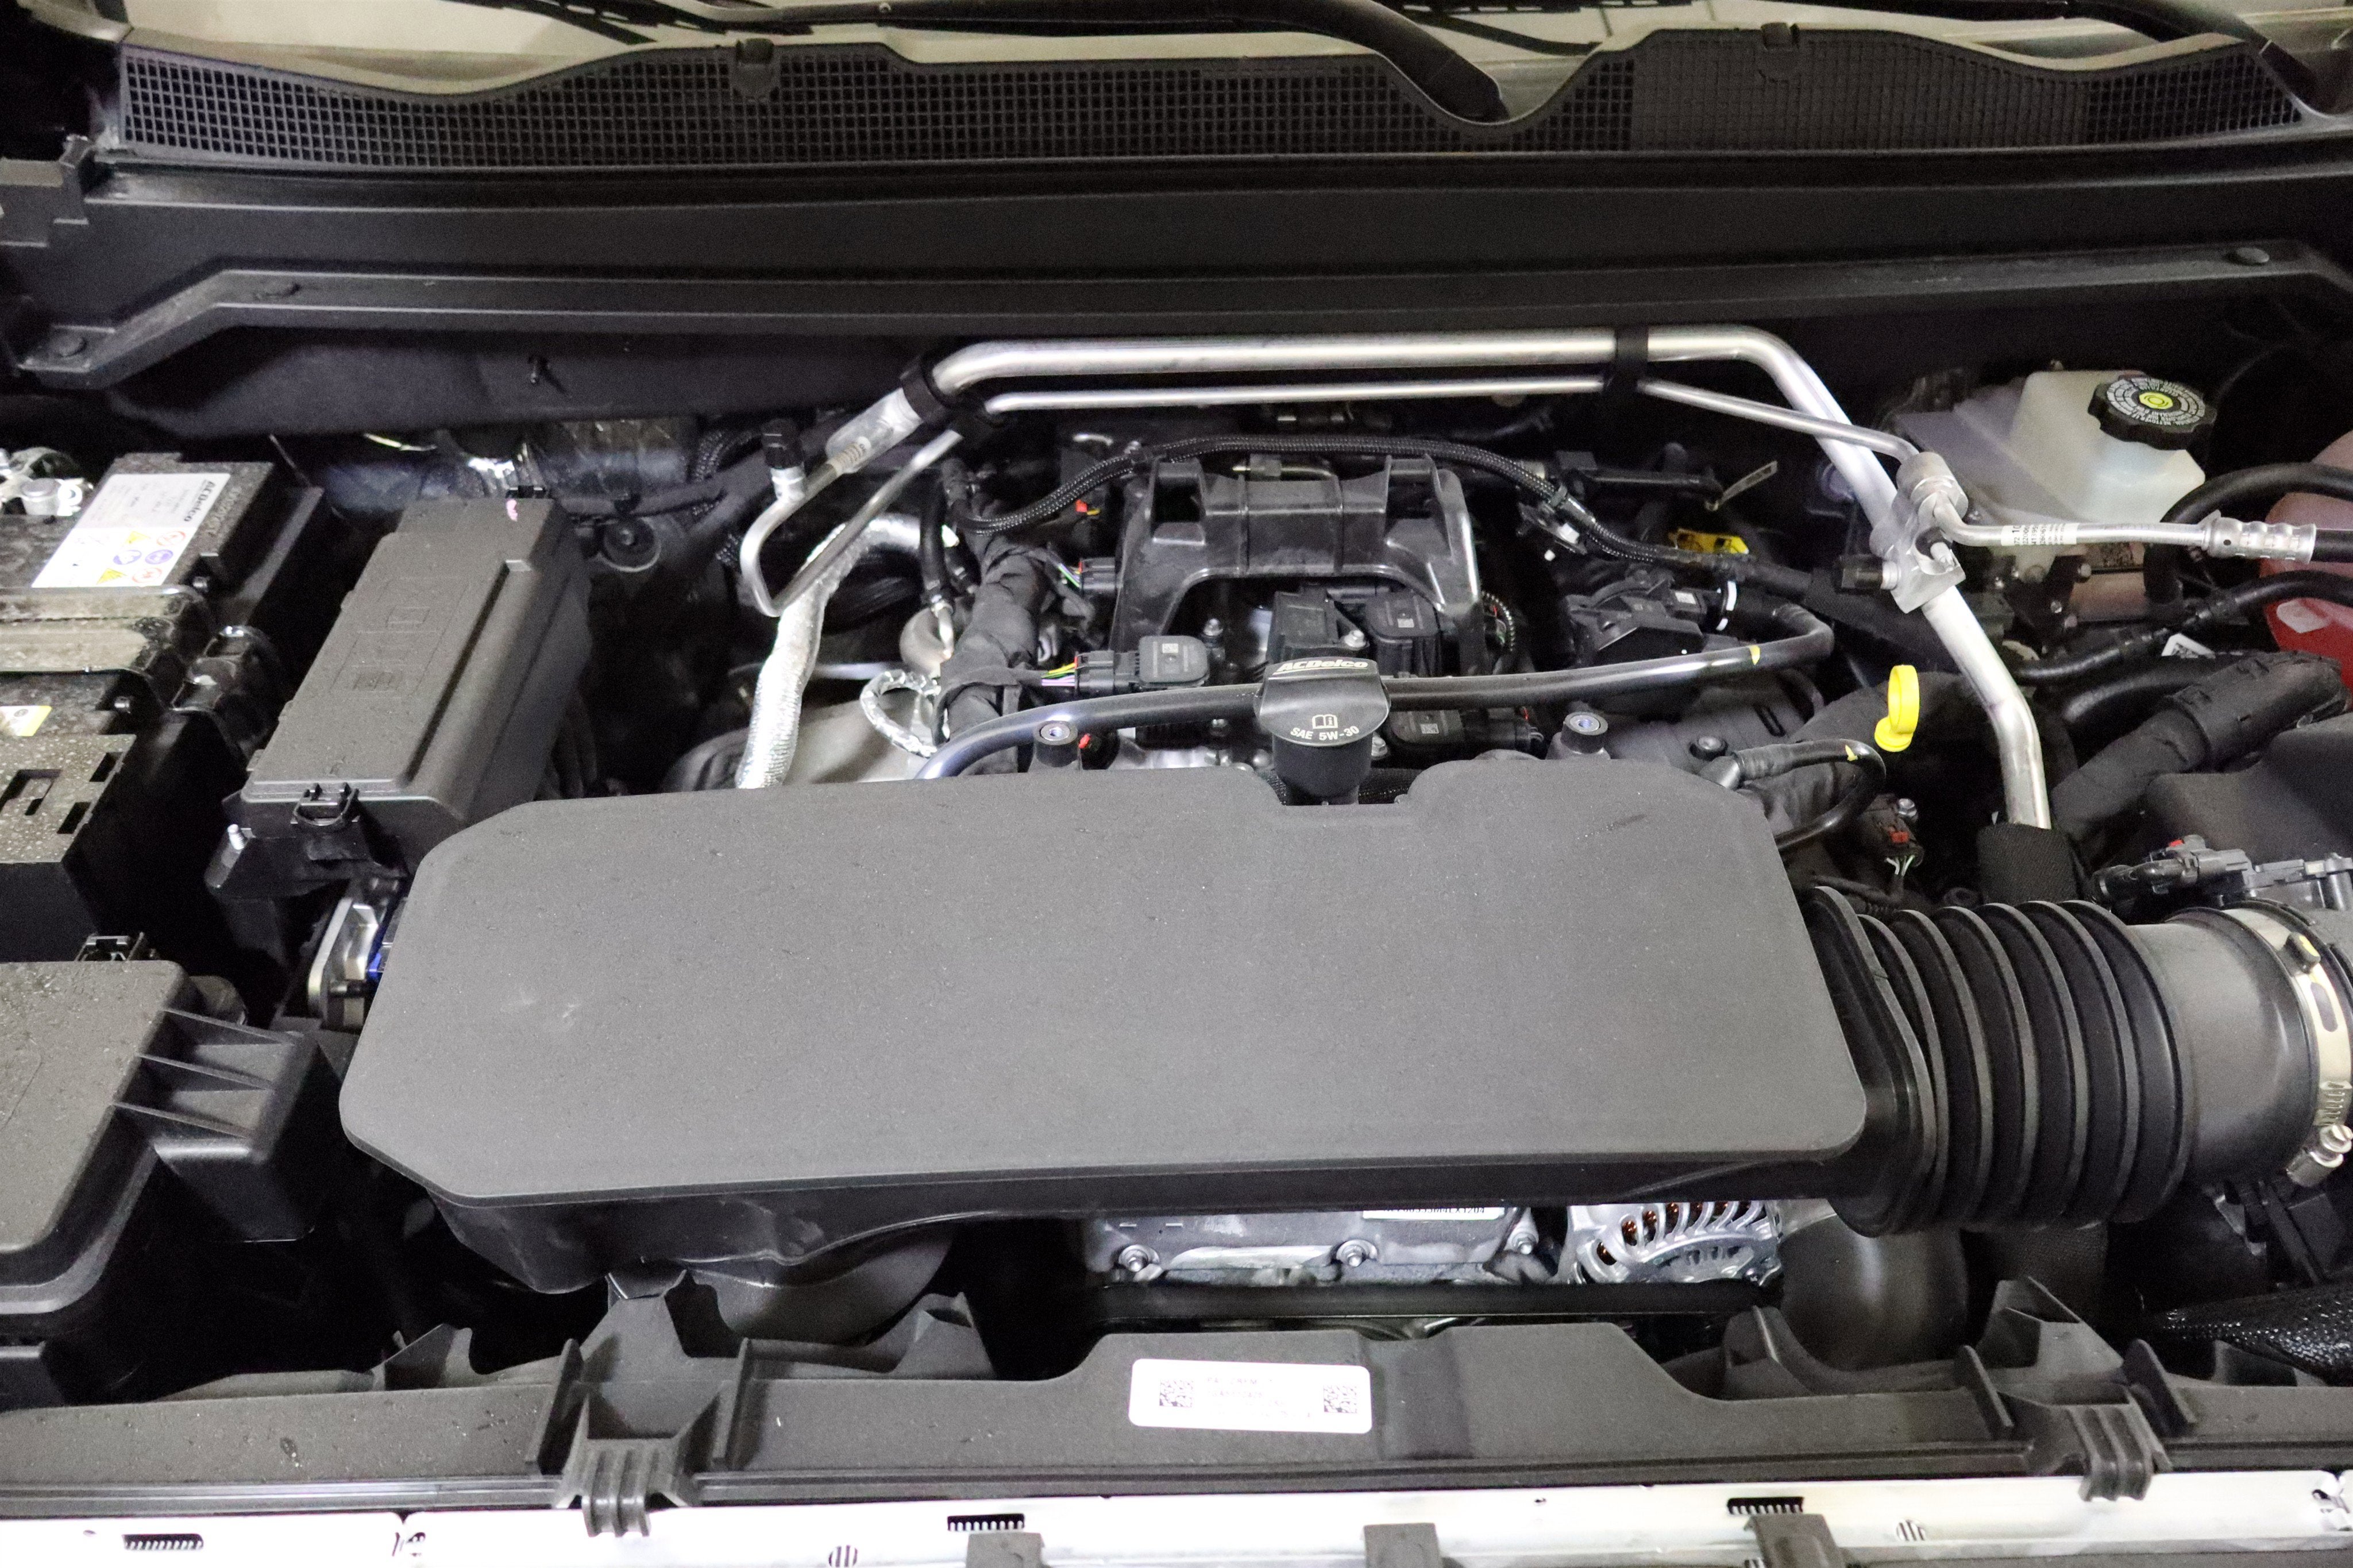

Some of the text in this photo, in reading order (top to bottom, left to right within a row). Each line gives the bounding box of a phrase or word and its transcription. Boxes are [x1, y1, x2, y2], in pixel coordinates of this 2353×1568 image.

[184, 481, 215, 522] ACDelco
[1277, 659, 1368, 671] ACDelco
[1290, 725, 1360, 741] SAE 5W-30
